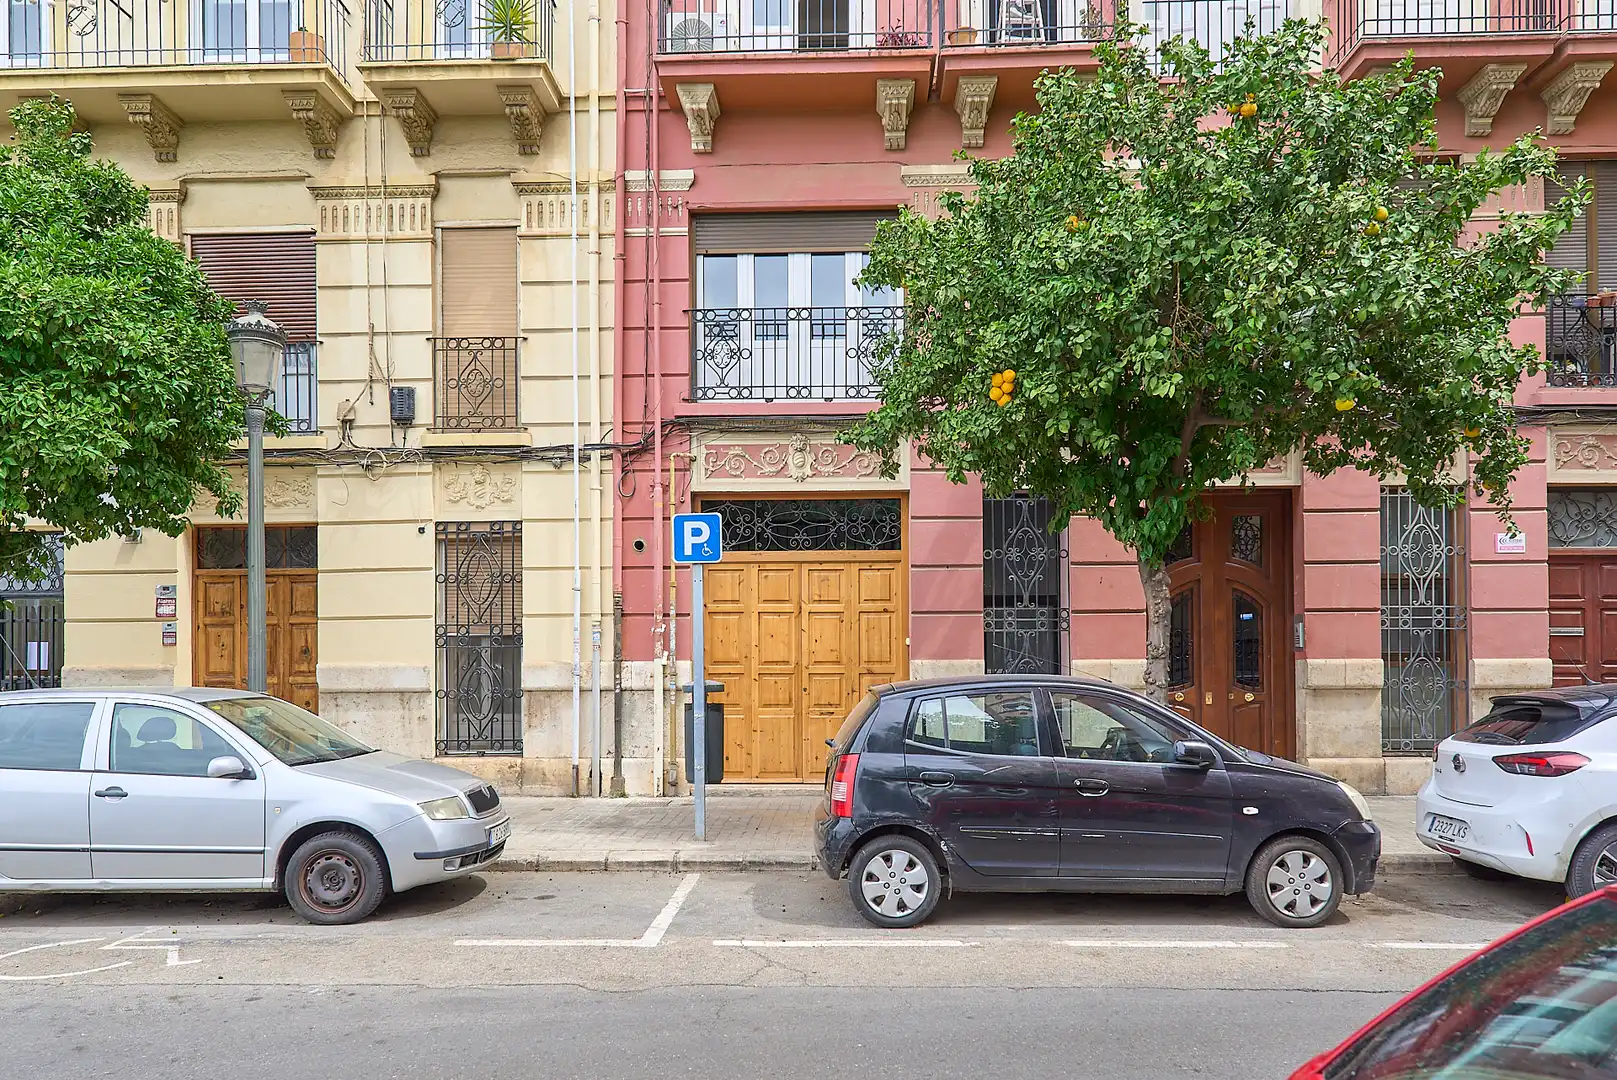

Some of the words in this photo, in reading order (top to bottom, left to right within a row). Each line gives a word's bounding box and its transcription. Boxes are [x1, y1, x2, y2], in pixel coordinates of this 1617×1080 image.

[684, 521, 710, 556] P
[1434, 820, 1453, 834] 2327
[1452, 824, 1468, 839] LKS
